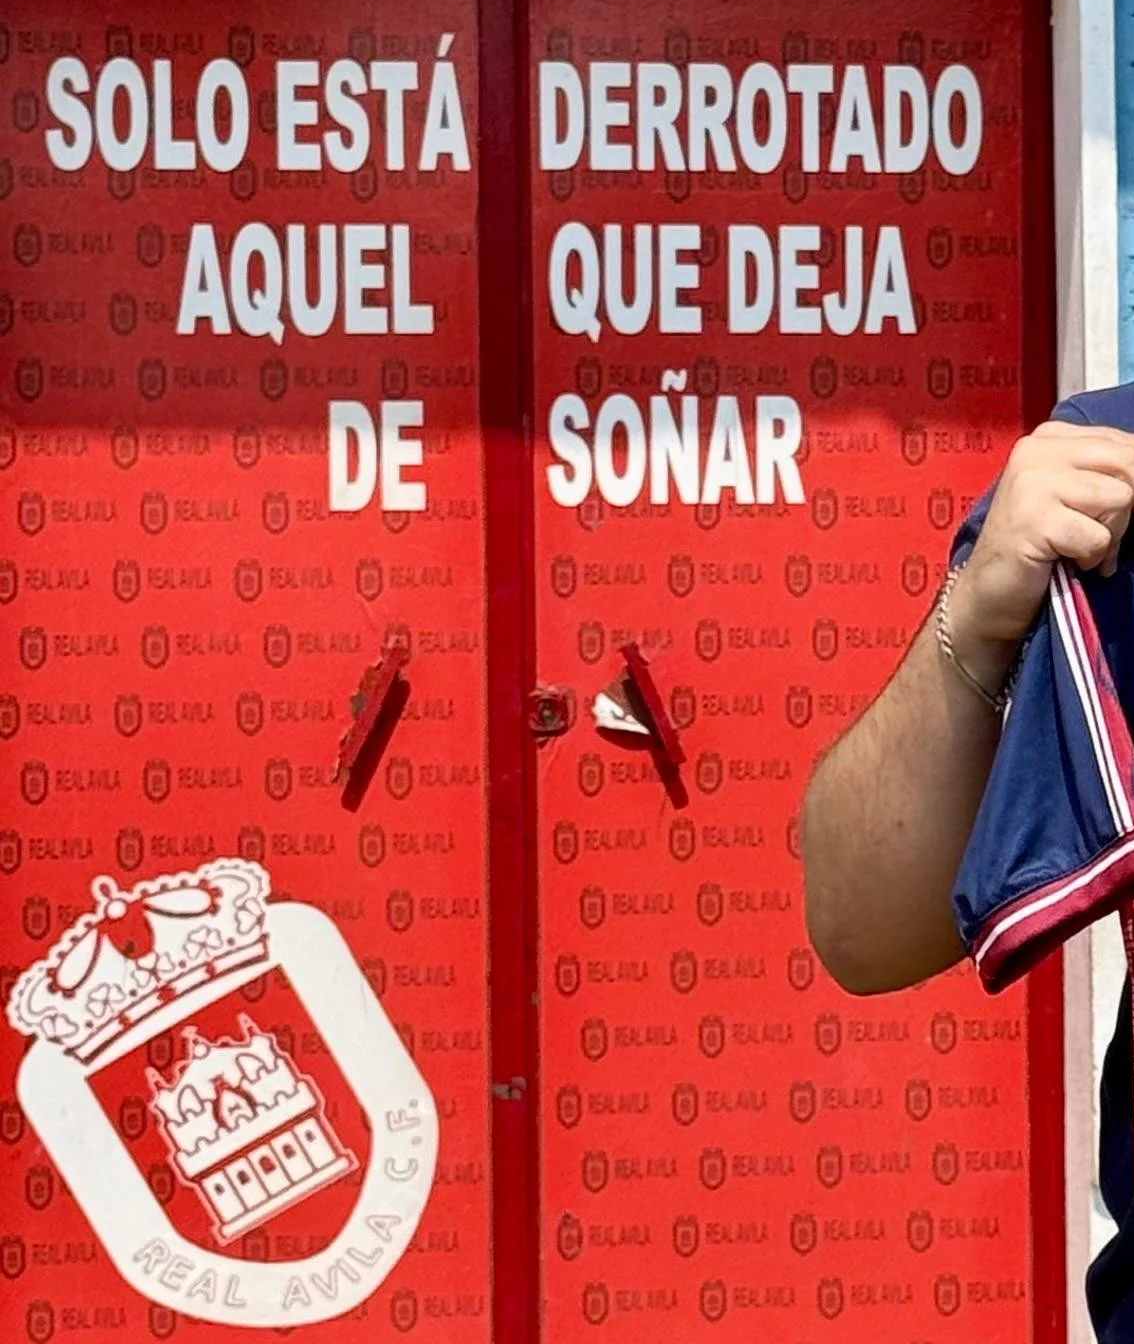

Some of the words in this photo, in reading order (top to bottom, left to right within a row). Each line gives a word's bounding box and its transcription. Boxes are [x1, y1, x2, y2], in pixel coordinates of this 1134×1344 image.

[45, 56, 250, 173] SOLO
[276, 33, 471, 173] ESTÁ
[539, 60, 983, 175] DERROTADO
[176, 222, 434, 345] AQUEL
[549, 221, 702, 343] QUE
[727, 224, 917, 336] DEJA
[327, 400, 427, 512] DE
[546, 369, 806, 507] SOÑAR
[131, 1237, 248, 1309] REAL
[281, 1214, 403, 1311] AVILA
